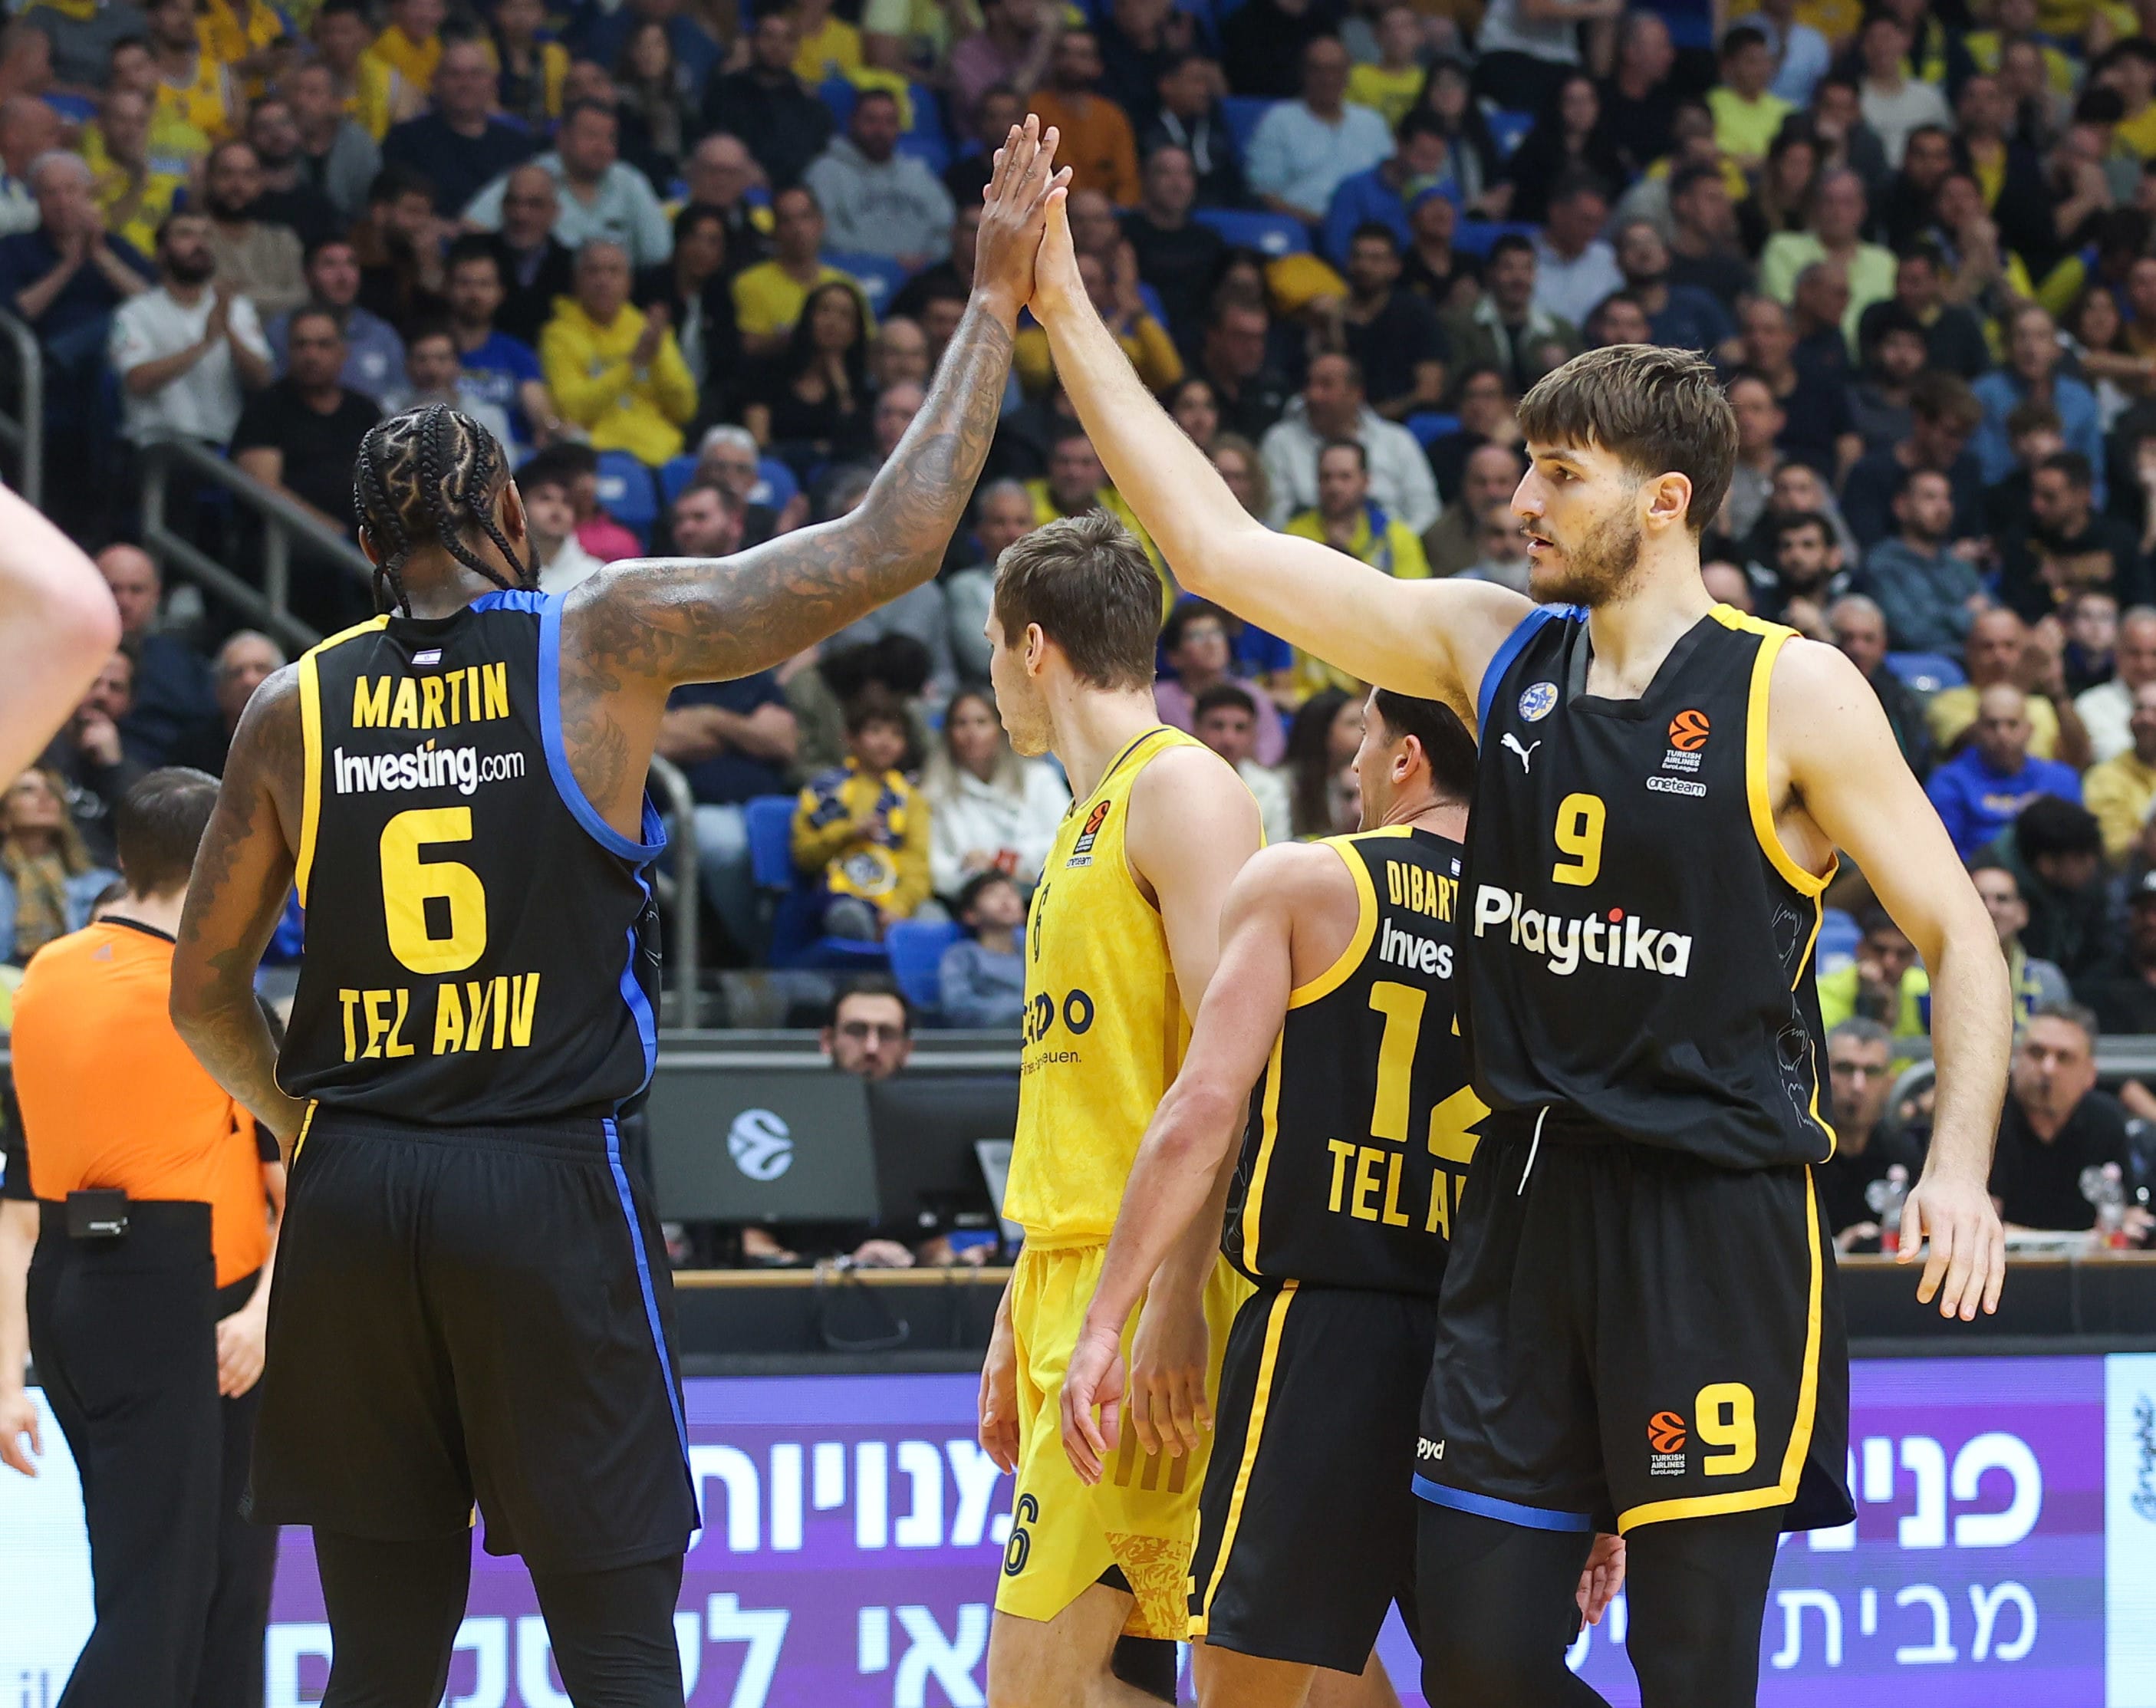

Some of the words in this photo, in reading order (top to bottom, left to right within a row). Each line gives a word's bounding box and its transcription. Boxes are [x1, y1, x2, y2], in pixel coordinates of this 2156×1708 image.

[352, 661, 509, 729] MARTIN
[334, 738, 525, 795] Investing.com
[1648, 778, 1705, 795] oneteam
[1664, 756, 1700, 767] AIRLINES
[1666, 749, 1702, 760] TURKISH
[1552, 792, 1606, 887] 9
[380, 805, 487, 975] 6
[1379, 917, 1454, 980] Inves
[1473, 884, 1693, 978] Playtika
[339, 988, 415, 1062] TEL
[432, 972, 541, 1056] AVIV
[1328, 1138, 1410, 1227] TEL
[1417, 1436, 1445, 1460] pyd
[1695, 1382, 1757, 1476] 9
[1651, 1468, 1685, 1476] EuroLeague
[1004, 1492, 1039, 1577] 6
[1770, 1581, 2039, 1669] מבית
